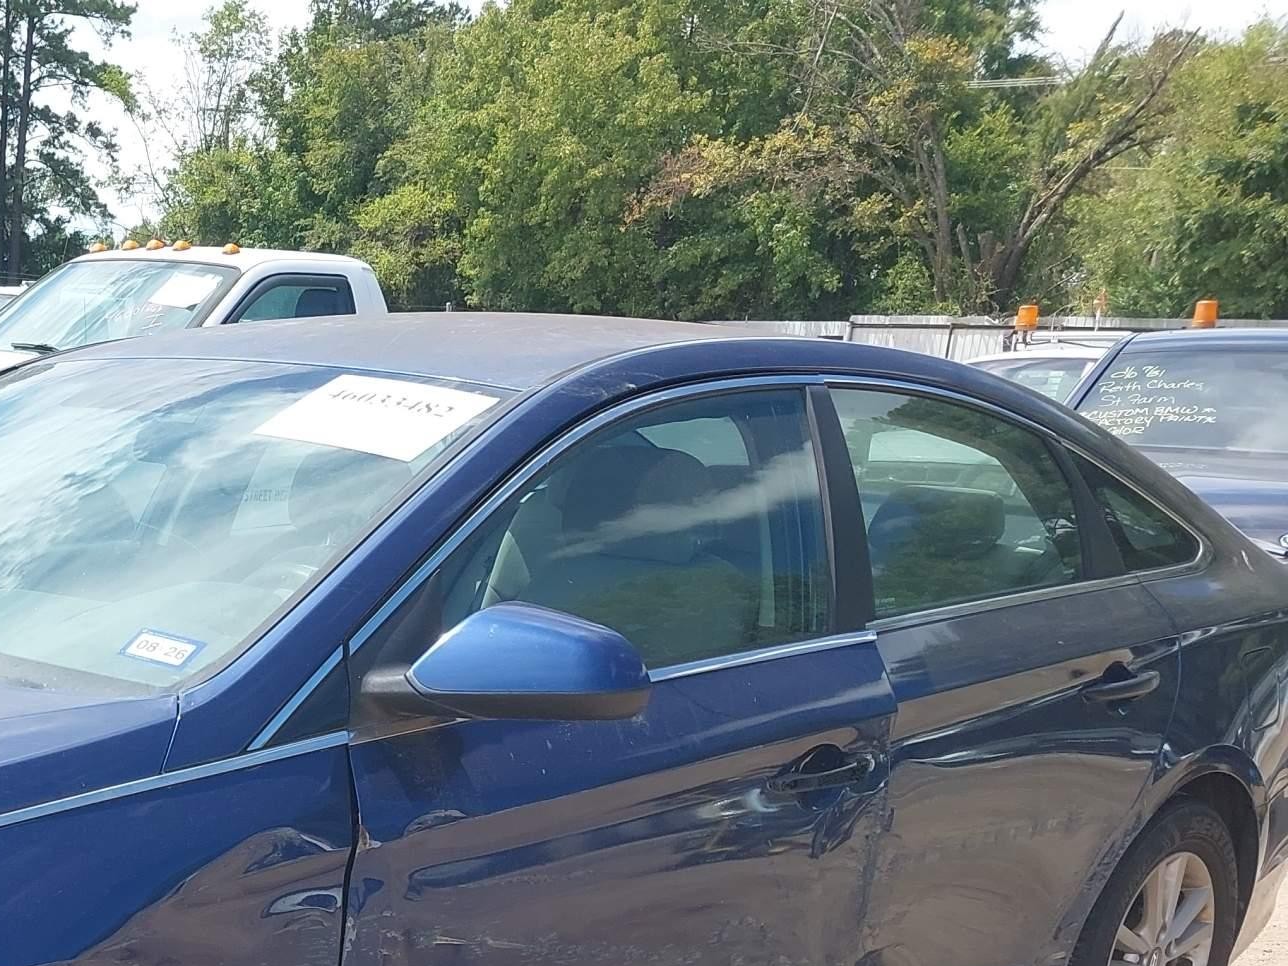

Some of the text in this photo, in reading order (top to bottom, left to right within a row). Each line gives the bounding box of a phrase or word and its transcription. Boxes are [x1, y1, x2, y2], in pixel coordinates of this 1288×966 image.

[328, 388, 455, 418] 46033482
[1154, 405, 1199, 416] BMW
[136, 639, 188, 660] 08 26
